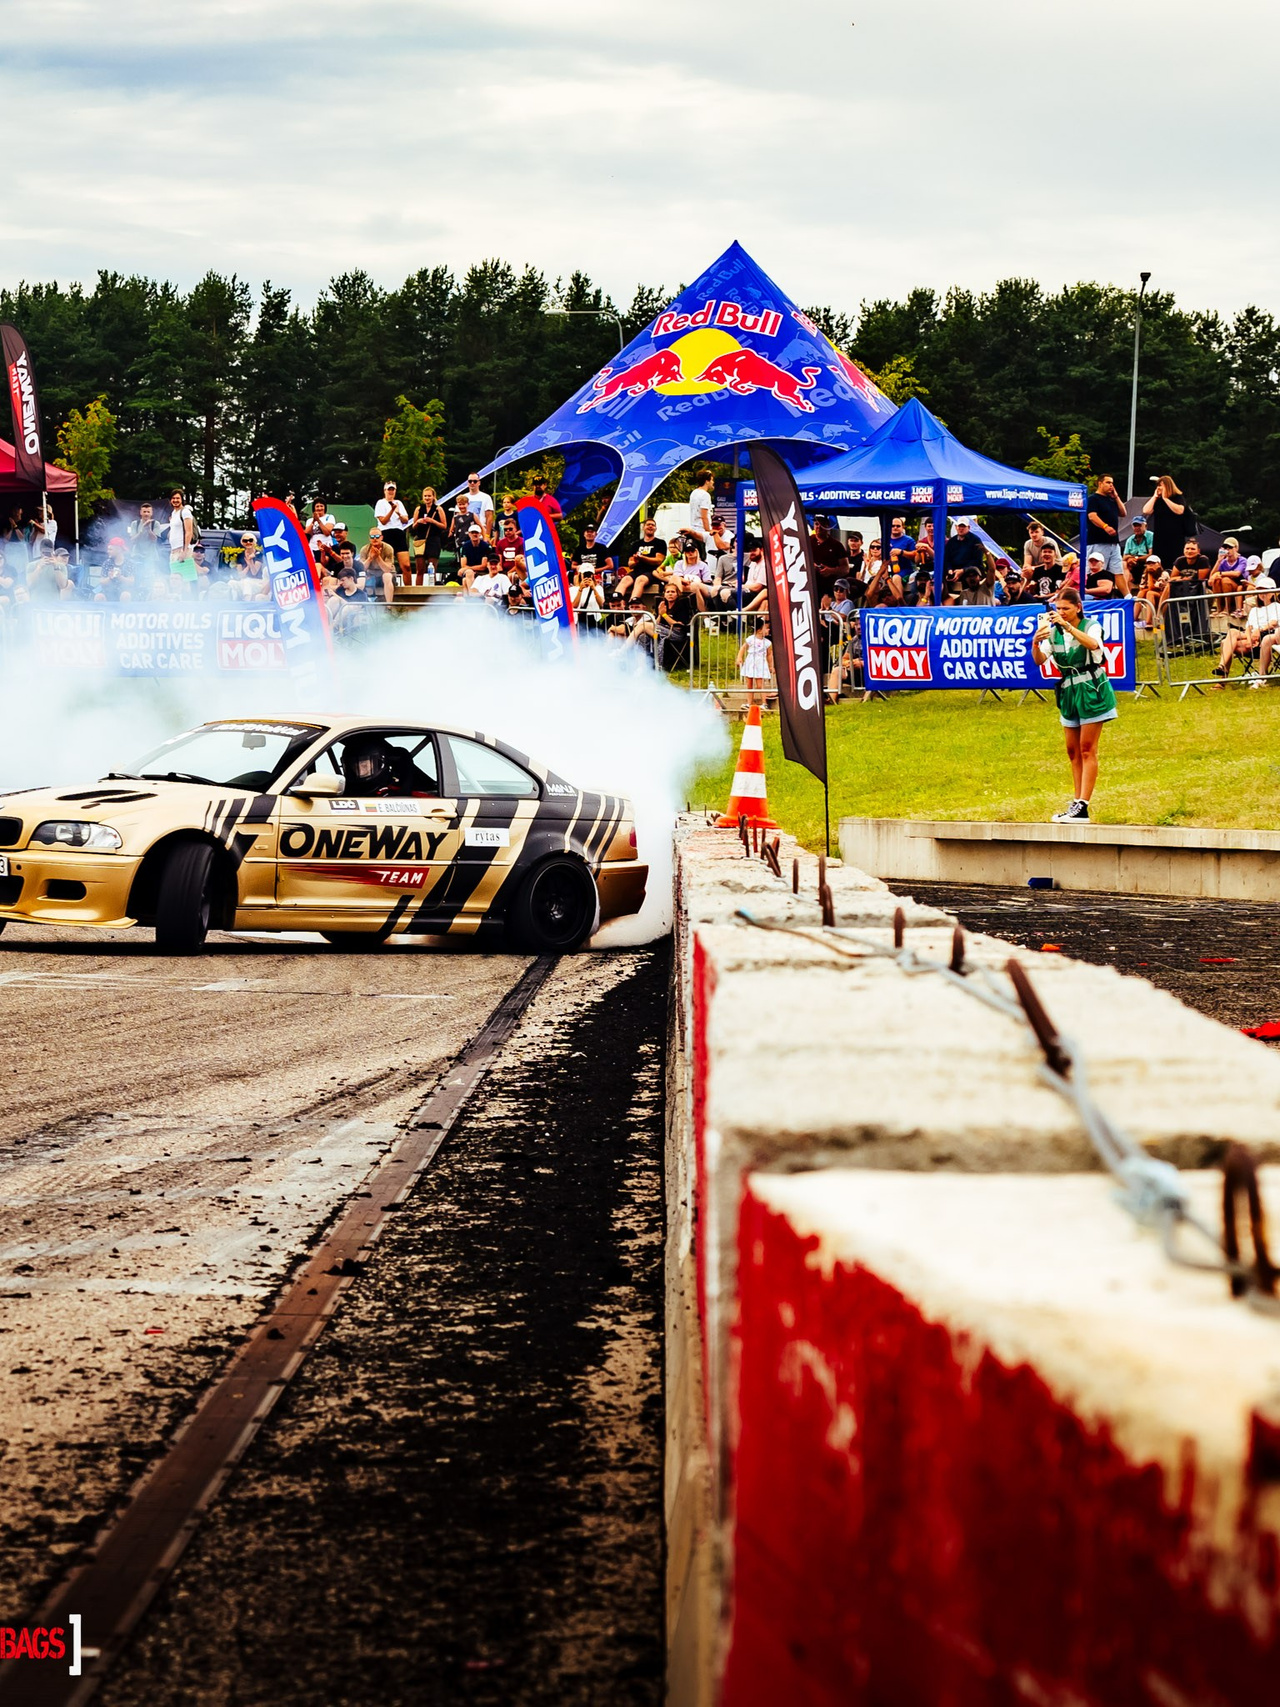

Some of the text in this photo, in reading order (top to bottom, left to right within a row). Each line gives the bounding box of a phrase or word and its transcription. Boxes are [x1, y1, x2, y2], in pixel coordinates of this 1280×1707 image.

[651, 300, 716, 338] Red
[714, 301, 783, 337] Bull
[818, 491, 861, 500] ADDITIVES
[865, 491, 882, 500] CAR
[883, 490, 906, 500] CARE
[111, 612, 212, 630] MOTOR OILS
[221, 612, 281, 640] LIQU
[934, 616, 1036, 636] MOTOR OILS
[116, 632, 205, 650] ADDITIVES
[869, 618, 929, 648] LIQUI
[221, 641, 285, 667] MOL
[939, 638, 1027, 658] ADDITIVES
[157, 652, 204, 669] CARE
[870, 650, 928, 677] MOLY
[943, 661, 1027, 680] CAR CARE
[331, 800, 357, 809] LDC
[280, 823, 448, 860] ONEWAY
[475, 832, 500, 844] rytas
[380, 870, 423, 884] TEAM
